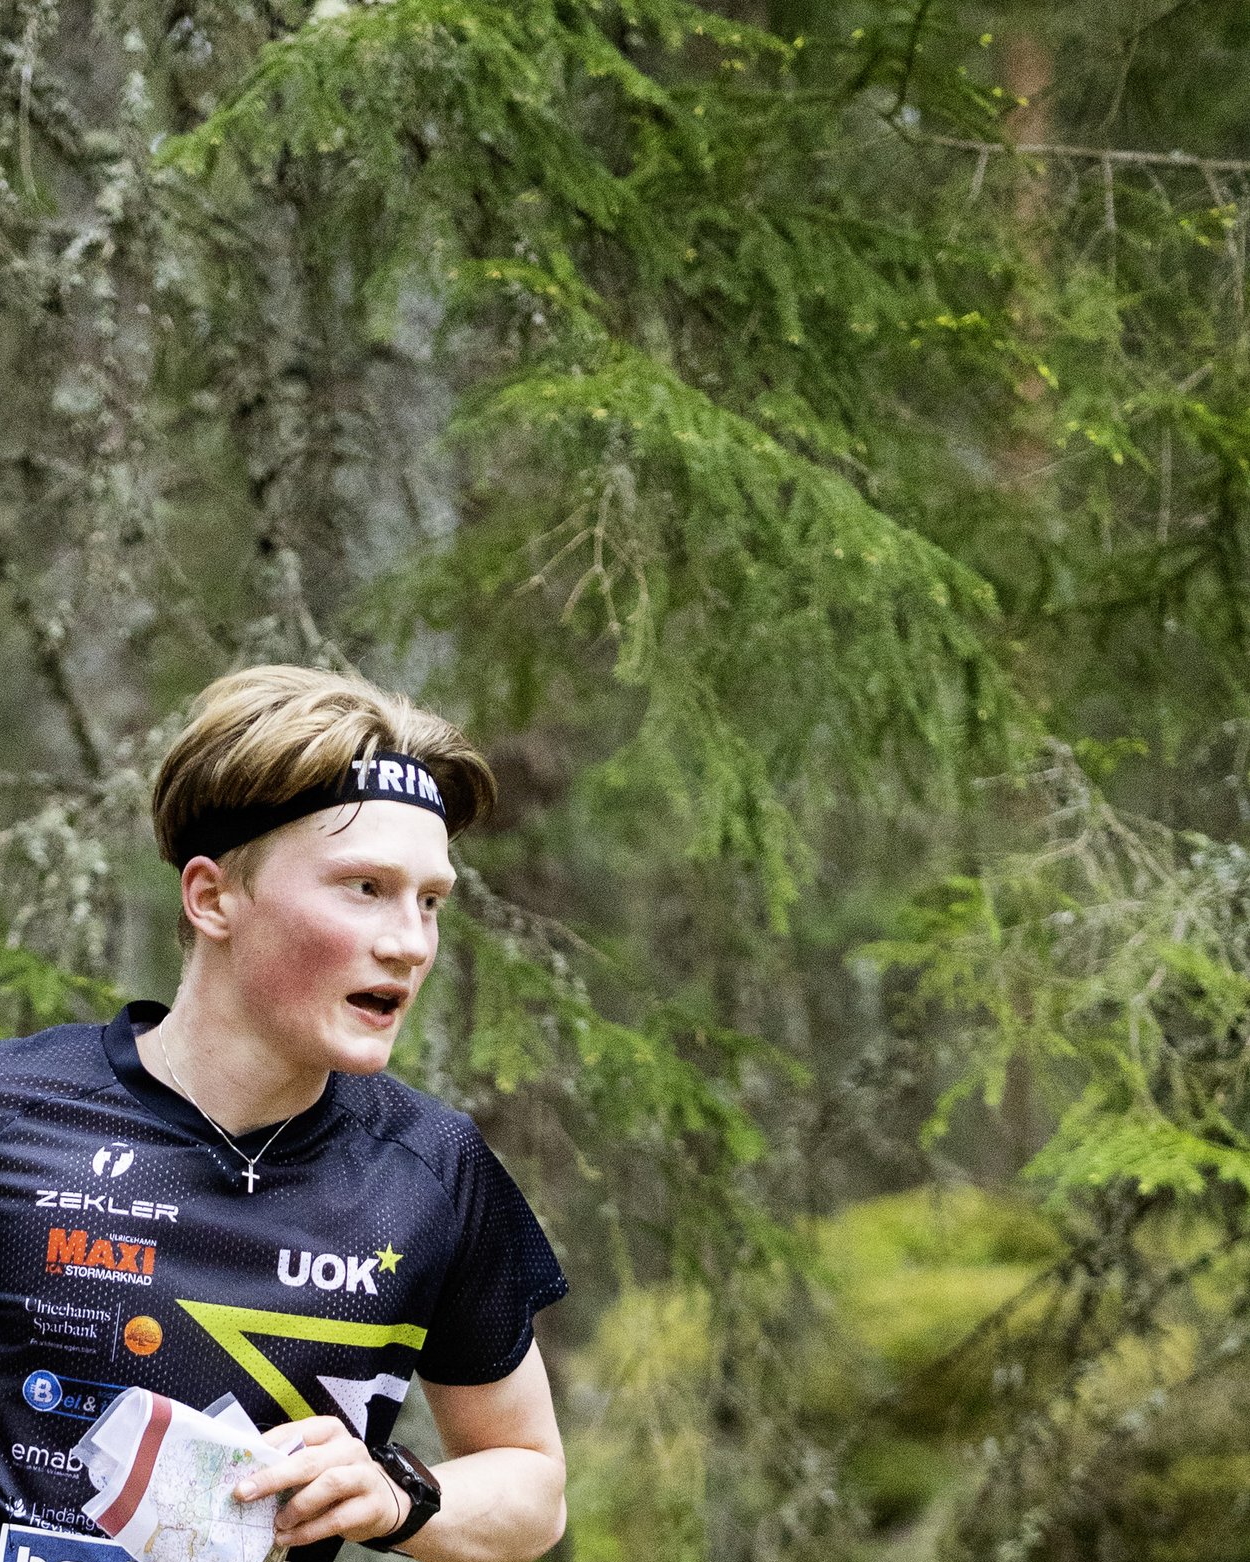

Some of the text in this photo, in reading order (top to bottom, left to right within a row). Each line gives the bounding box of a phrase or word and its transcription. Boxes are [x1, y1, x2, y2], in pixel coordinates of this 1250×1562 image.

[36, 1190, 179, 1222] ZEKLER
[46, 1228, 156, 1275] MAXI
[109, 1233, 157, 1247] ULRICEHAMN
[65, 1265, 152, 1286] STORMARKNAD
[277, 1249, 380, 1296] UOK
[25, 1297, 111, 1322] Ulricehamns
[33, 1317, 98, 1338] Sparbank
[12, 1443, 83, 1472] emab
[33, 1502, 102, 1530] Lindäng
